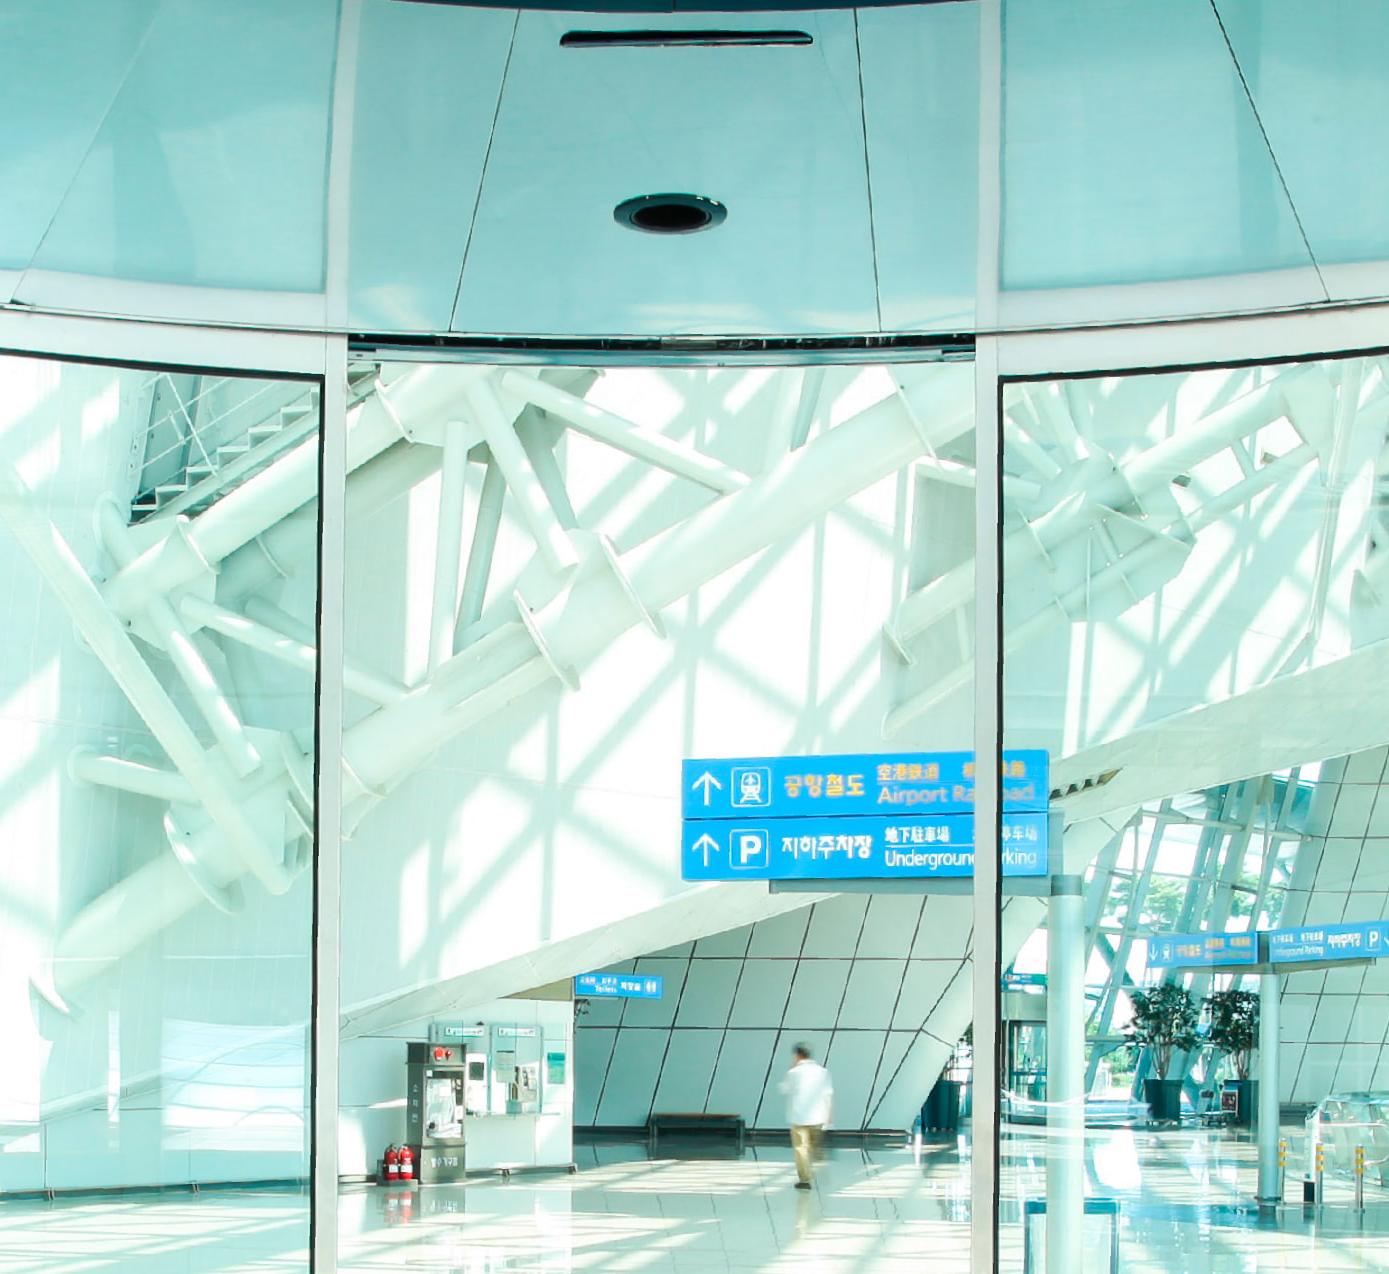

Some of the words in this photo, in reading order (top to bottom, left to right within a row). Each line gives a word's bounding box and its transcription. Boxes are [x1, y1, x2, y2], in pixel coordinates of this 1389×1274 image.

[784, 774, 865, 798] 공항철도
[877, 786, 948, 805] Airport
[781, 834, 873, 860] 지하주차장
[1002, 848, 1037, 867] rking
